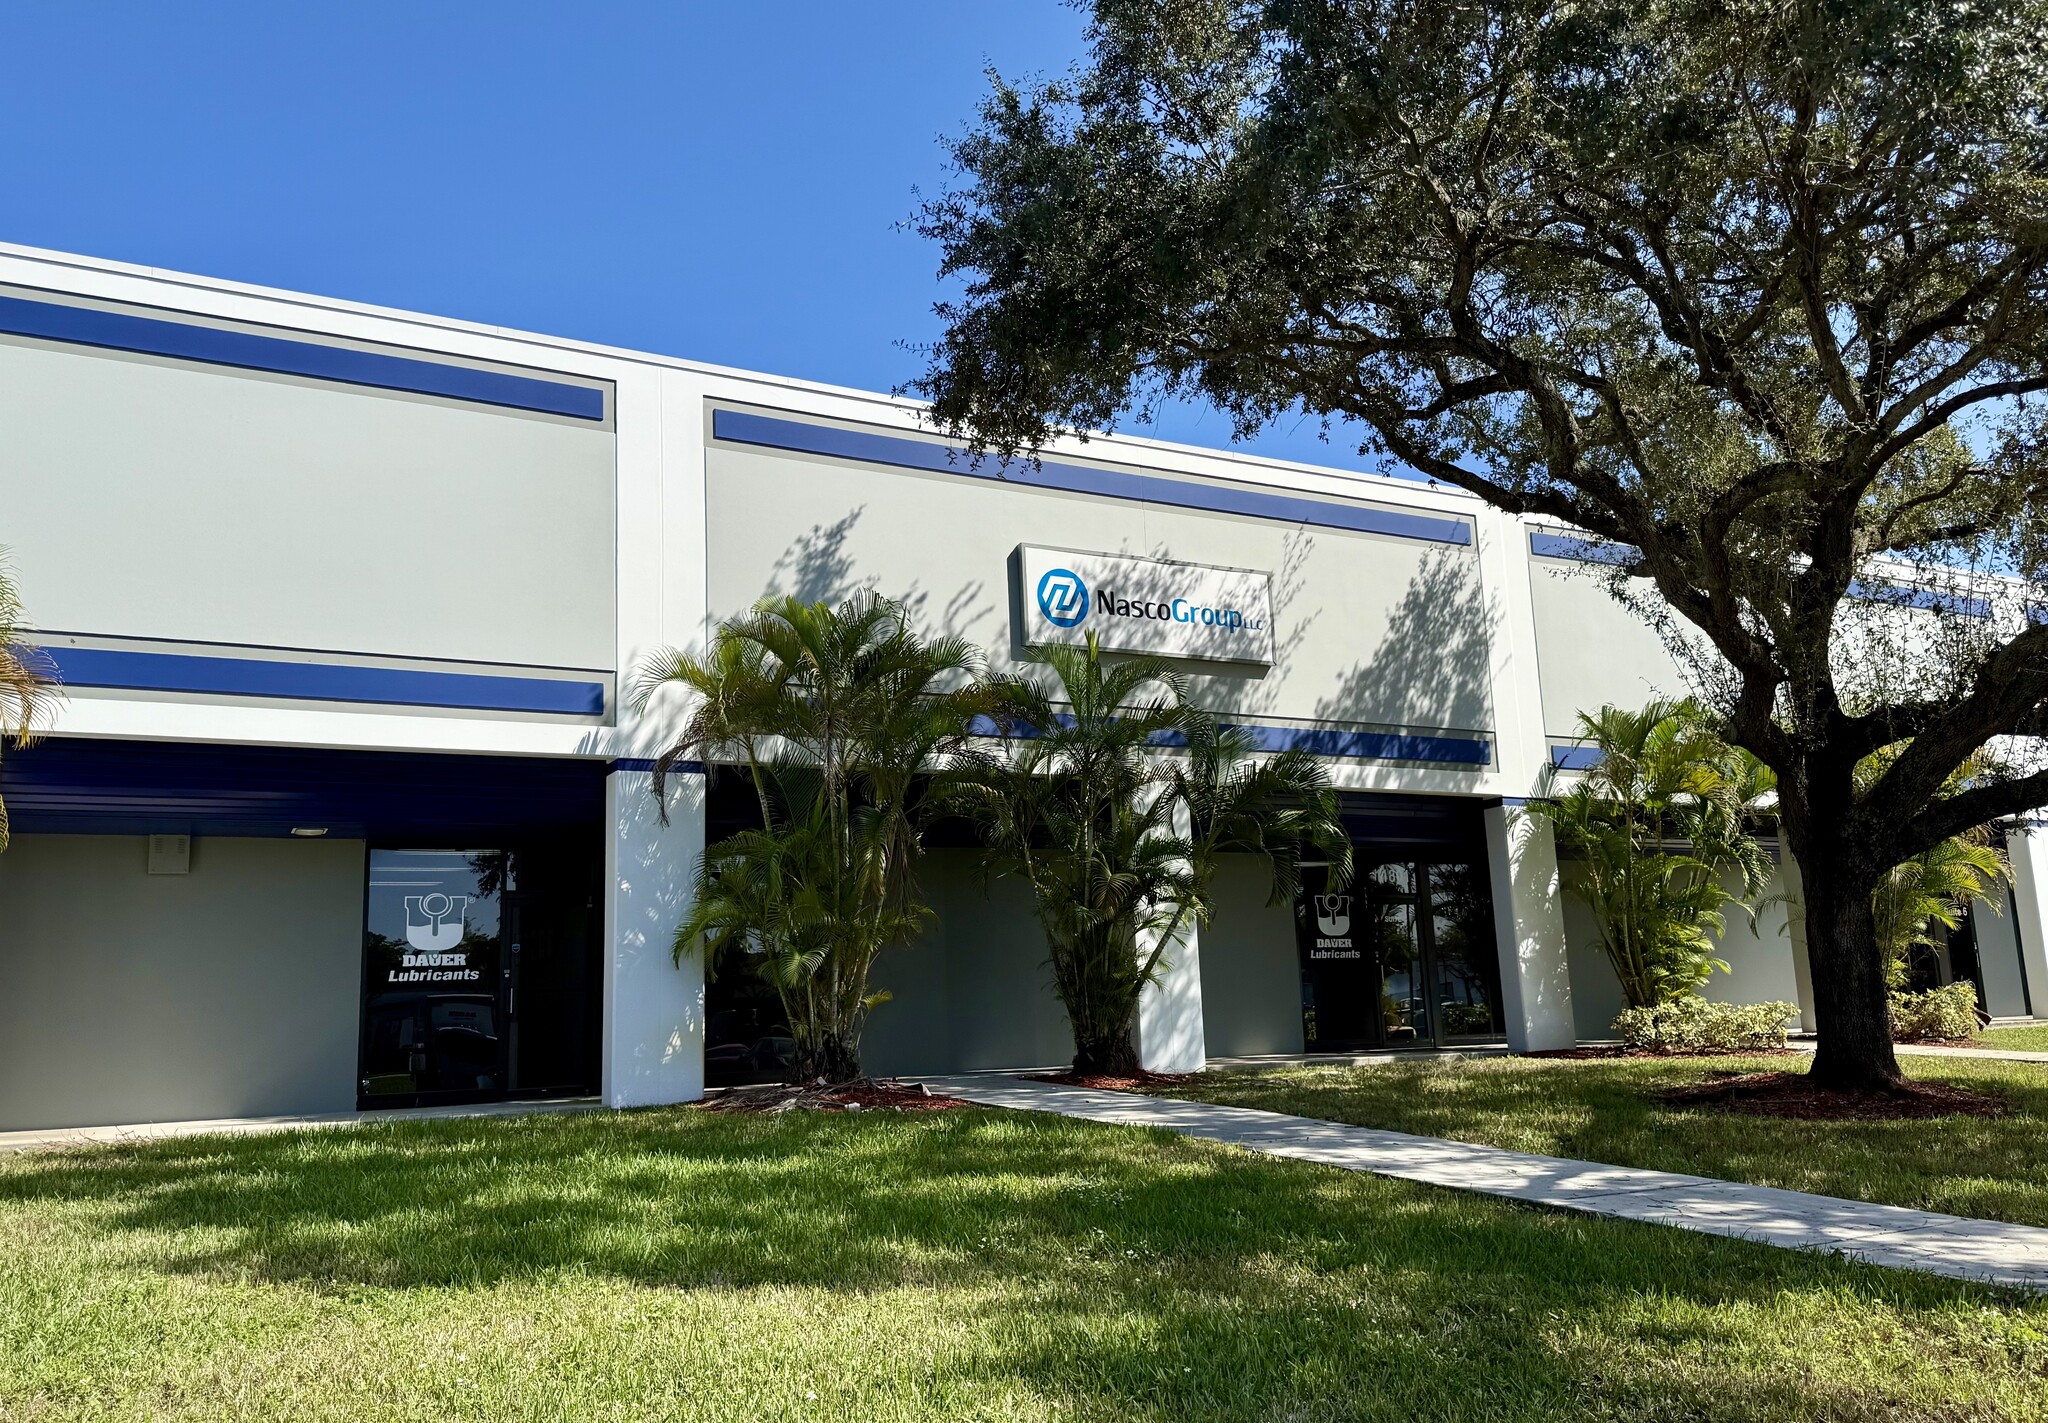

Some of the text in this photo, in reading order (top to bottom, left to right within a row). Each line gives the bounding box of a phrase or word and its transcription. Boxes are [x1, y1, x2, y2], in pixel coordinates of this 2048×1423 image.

[1097, 589, 1263, 633] NascoGroup LLC
[1962, 907, 1968, 916] 6
[1316, 938, 1352, 948] DAUER
[1310, 950, 1361, 959] Lubricants
[402, 954, 466, 967] DAUER
[388, 969, 480, 982] Lubricants
